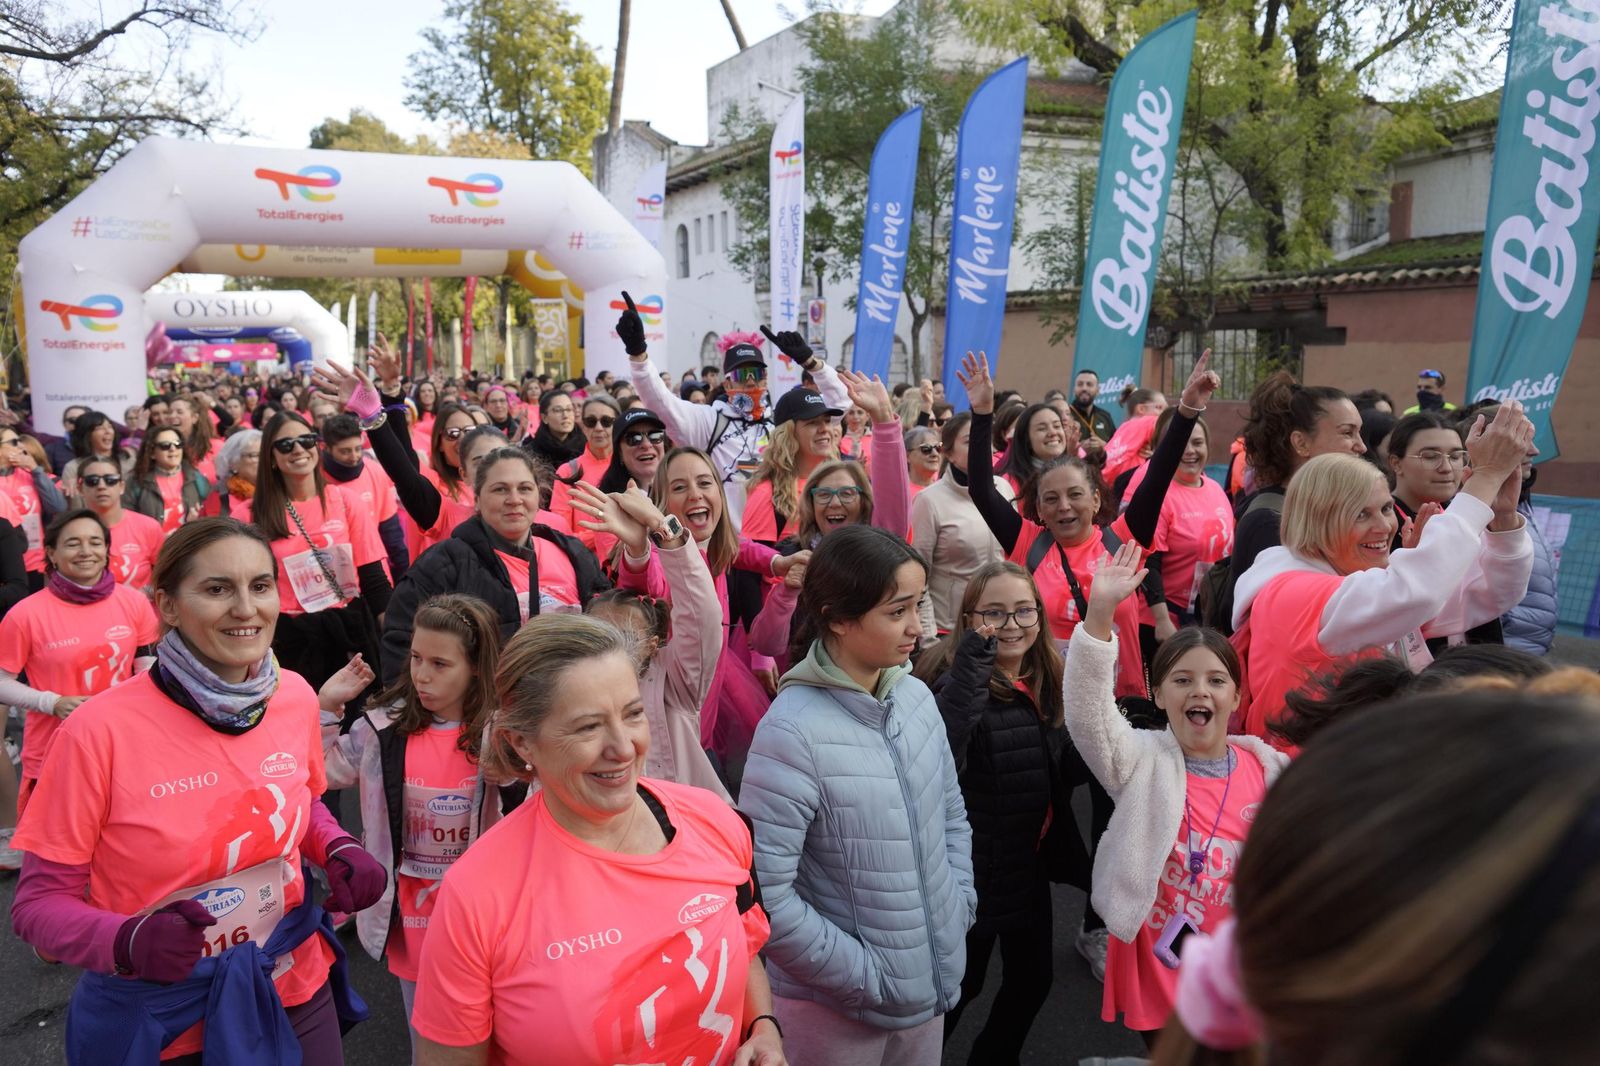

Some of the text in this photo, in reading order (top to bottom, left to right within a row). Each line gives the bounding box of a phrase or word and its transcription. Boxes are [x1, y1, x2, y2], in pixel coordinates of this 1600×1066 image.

[1491, 0, 1600, 320] Batist
[257, 208, 344, 223] TotalEnergies
[429, 214, 505, 227] TotalEnergies
[1092, 86, 1173, 337] Batiste
[955, 166, 1008, 304] Marlene
[863, 202, 905, 323] Marlene
[173, 299, 272, 318] OYSHO
[43, 339, 126, 352] TotalEnergies
[45, 393, 128, 403] totalenergies.es
[150, 771, 218, 799] OYSHO
[431, 801, 471, 811] ASTURIANA
[412, 864, 442, 876] OYSHO
[206, 894, 242, 914] URIANA
[546, 927, 622, 960] OYSHO
